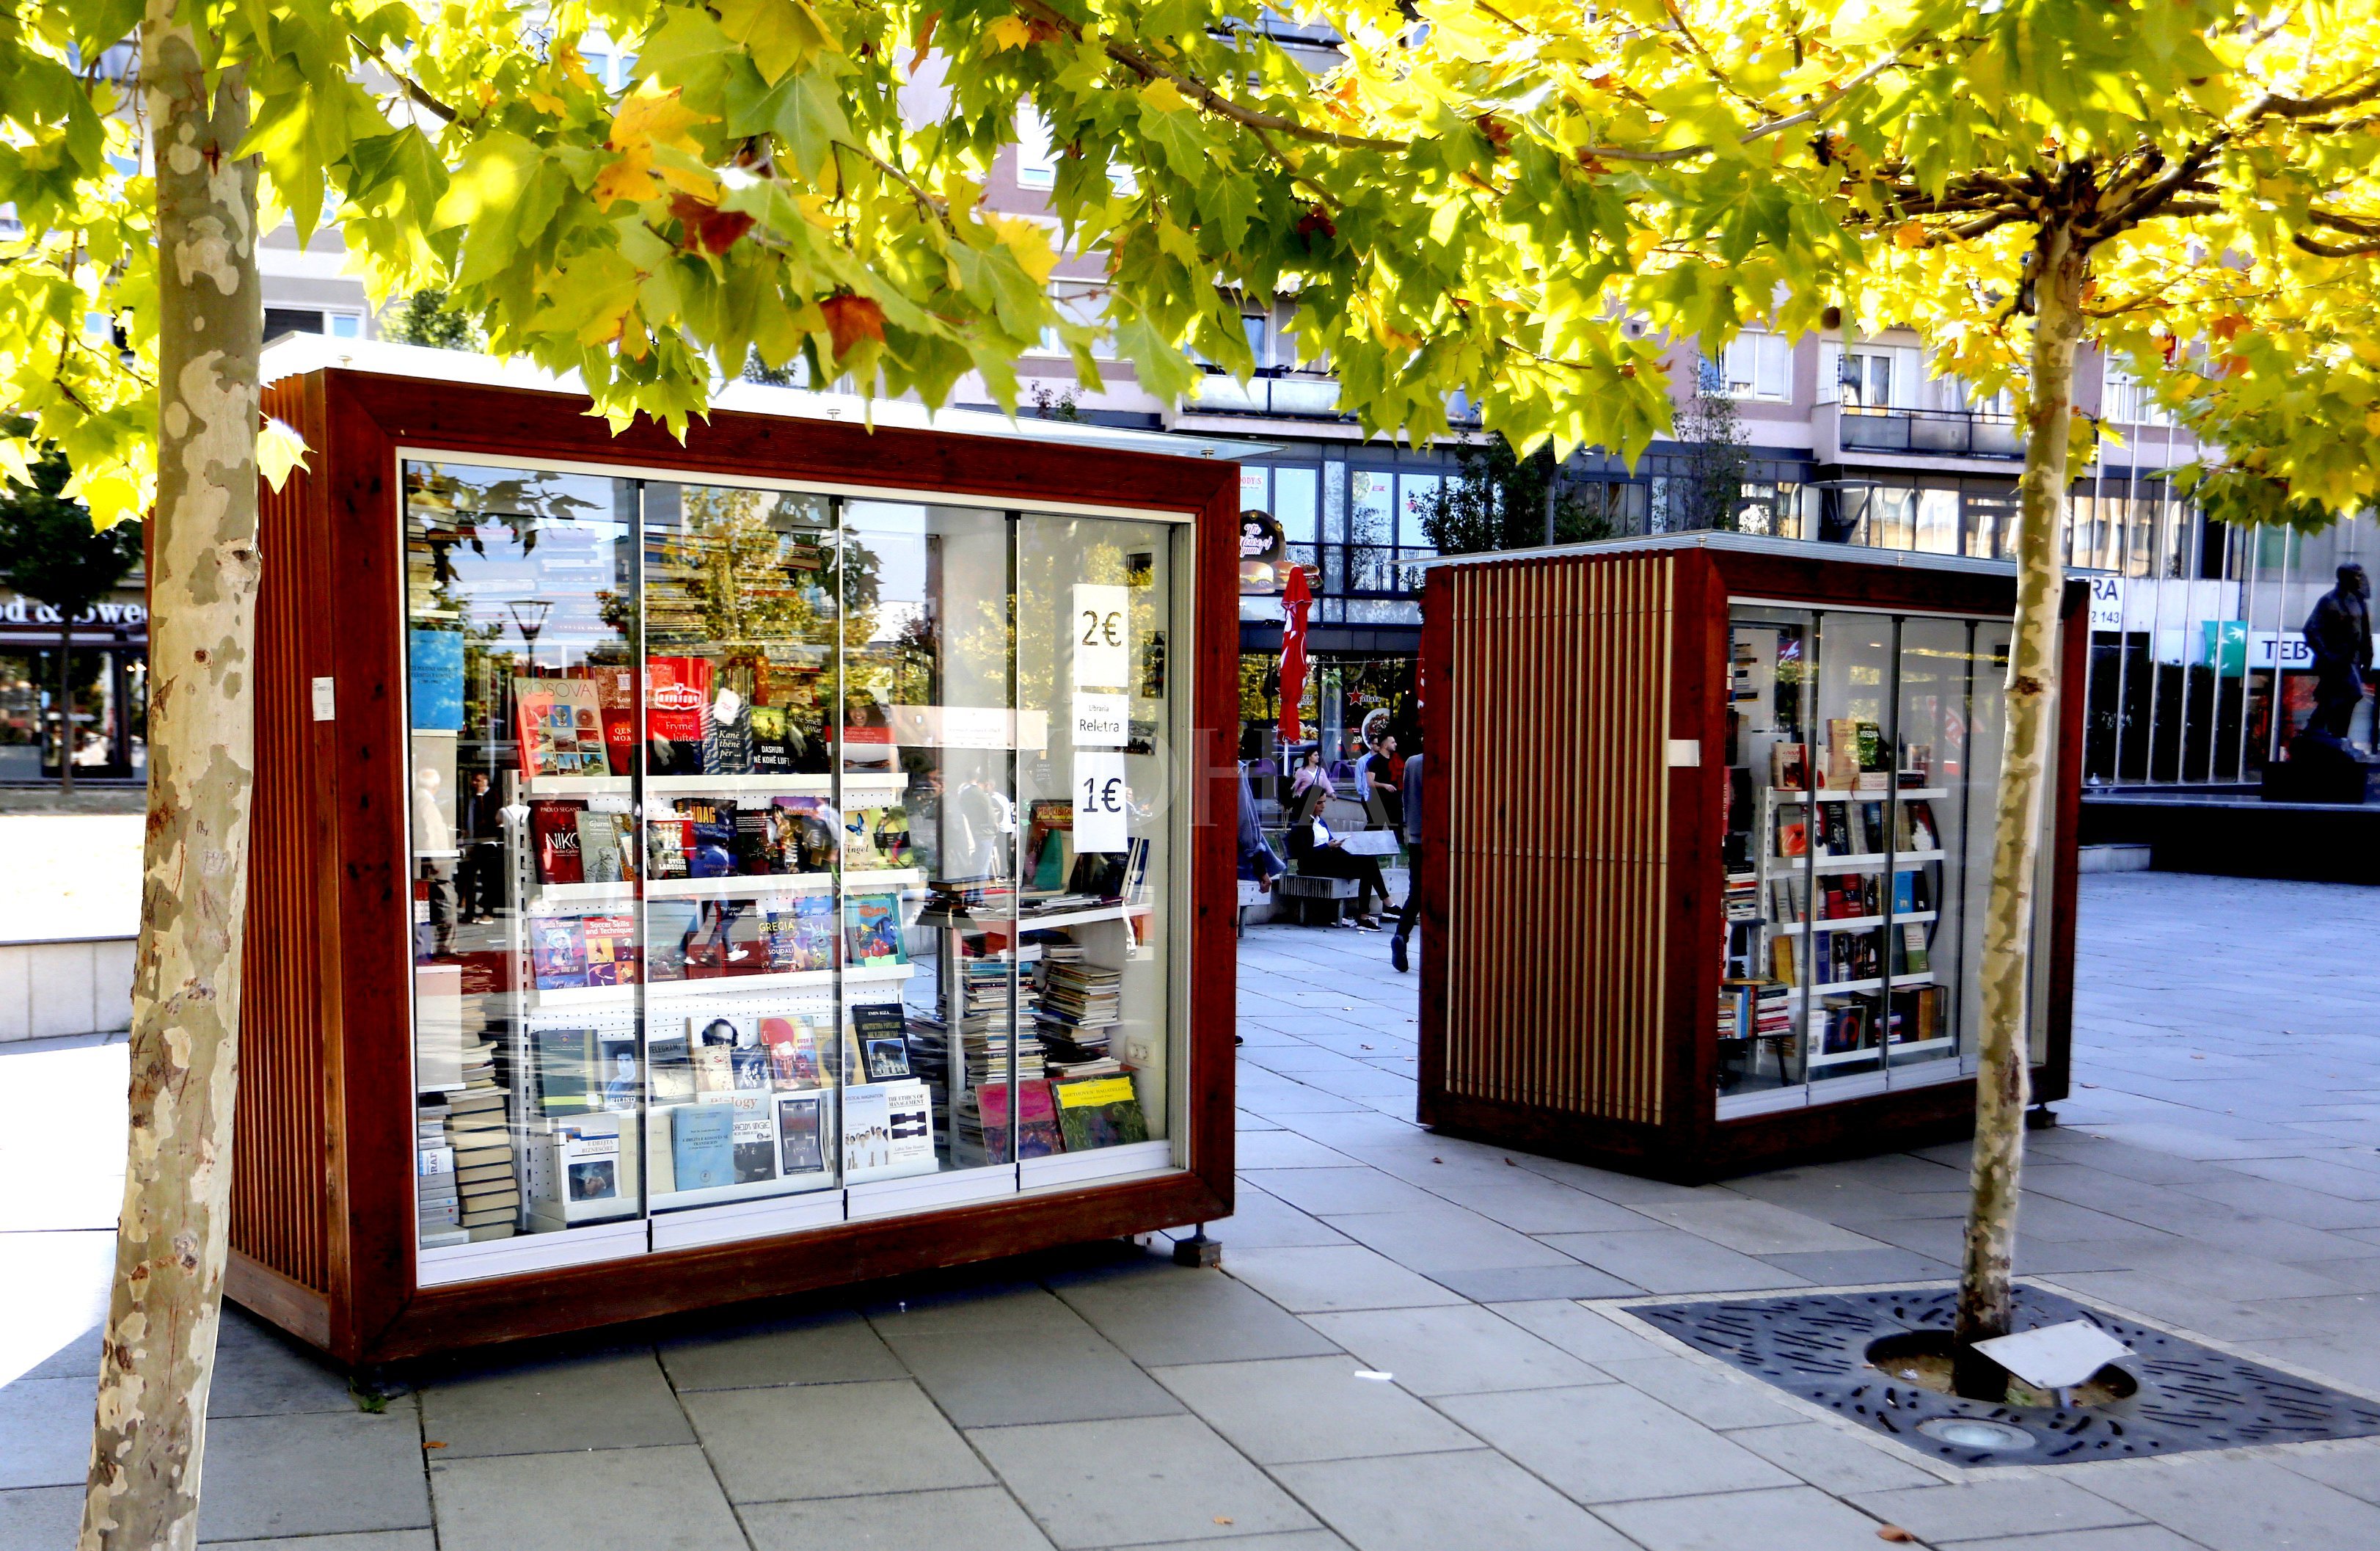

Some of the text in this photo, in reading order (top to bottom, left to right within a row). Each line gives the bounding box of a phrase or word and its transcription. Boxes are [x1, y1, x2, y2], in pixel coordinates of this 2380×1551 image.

[1244, 523, 1262, 536] The
[2100, 611, 2120, 624] 143
[1081, 610, 1122, 647] 2€
[2261, 639, 2308, 660] TEB
[519, 682, 593, 698] KOSOVA
[1089, 704, 1109, 713] Libraria
[794, 715, 822, 726] The Smell
[1079, 719, 1120, 733] Reletra
[719, 730, 740, 739] Kanë
[810, 726, 822, 734] War
[719, 739, 741, 748] thënë
[719, 748, 734, 759] për
[761, 745, 784, 754] DASHURI
[753, 755, 762, 763] NË
[762, 755, 777, 764] KOHË
[1083, 778, 1123, 813] 1€
[759, 921, 795, 932] GRECIA
[888, 1099, 924, 1107] MANAGEMENT
